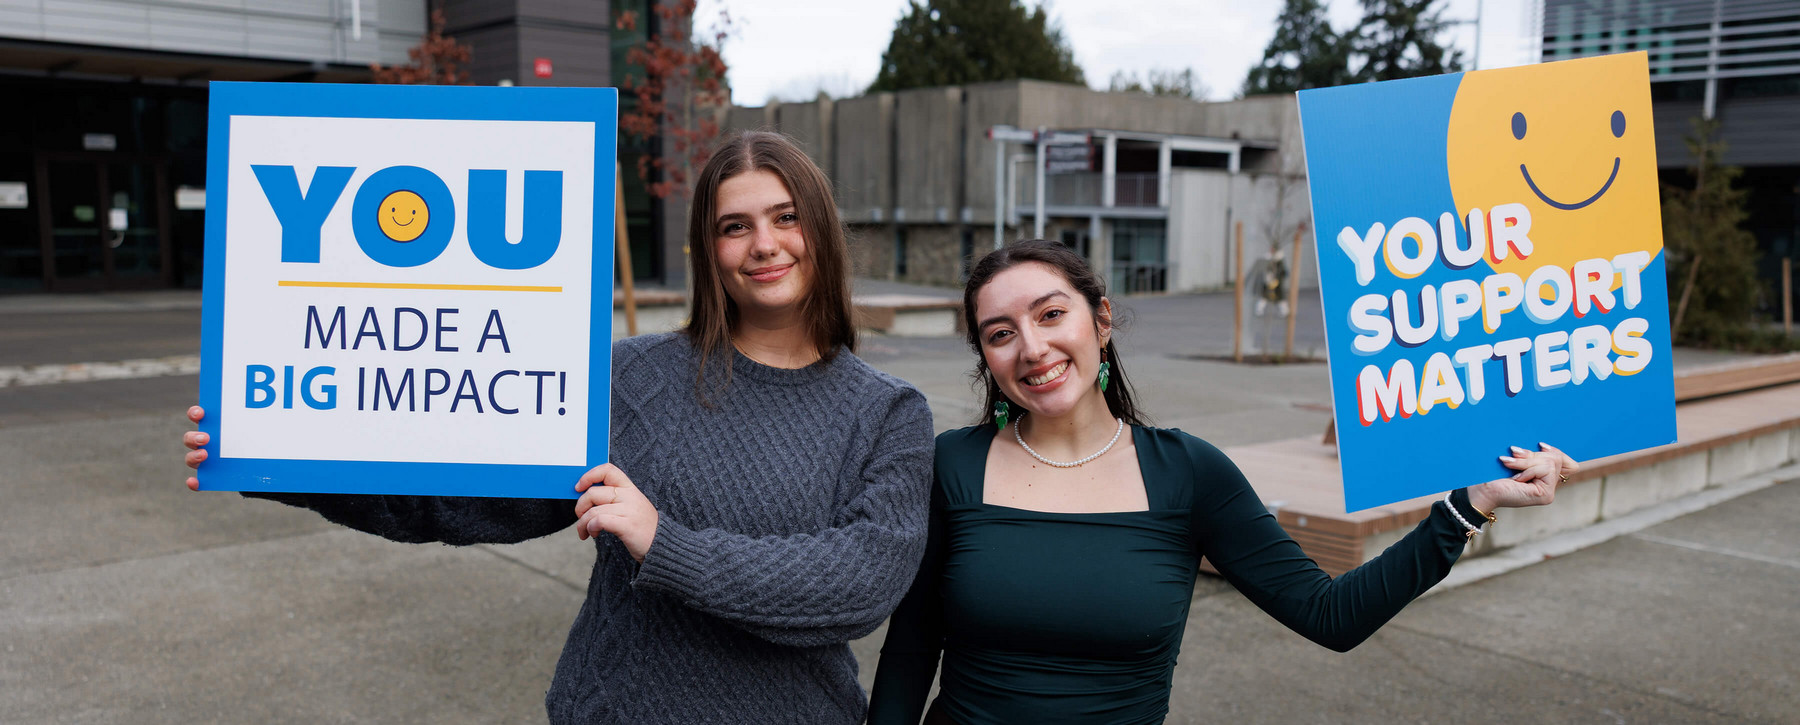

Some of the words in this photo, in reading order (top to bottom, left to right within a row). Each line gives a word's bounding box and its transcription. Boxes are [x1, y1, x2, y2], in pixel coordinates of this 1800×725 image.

[250, 164, 563, 270] YOU
[1337, 203, 1534, 286] YOUR
[304, 305, 460, 353] MADE
[476, 309, 511, 354] A
[1347, 250, 1651, 356] SUPPORT
[245, 364, 338, 411] BIG
[357, 367, 567, 416] IMPACT!
[1356, 317, 1653, 427] MATTERS
